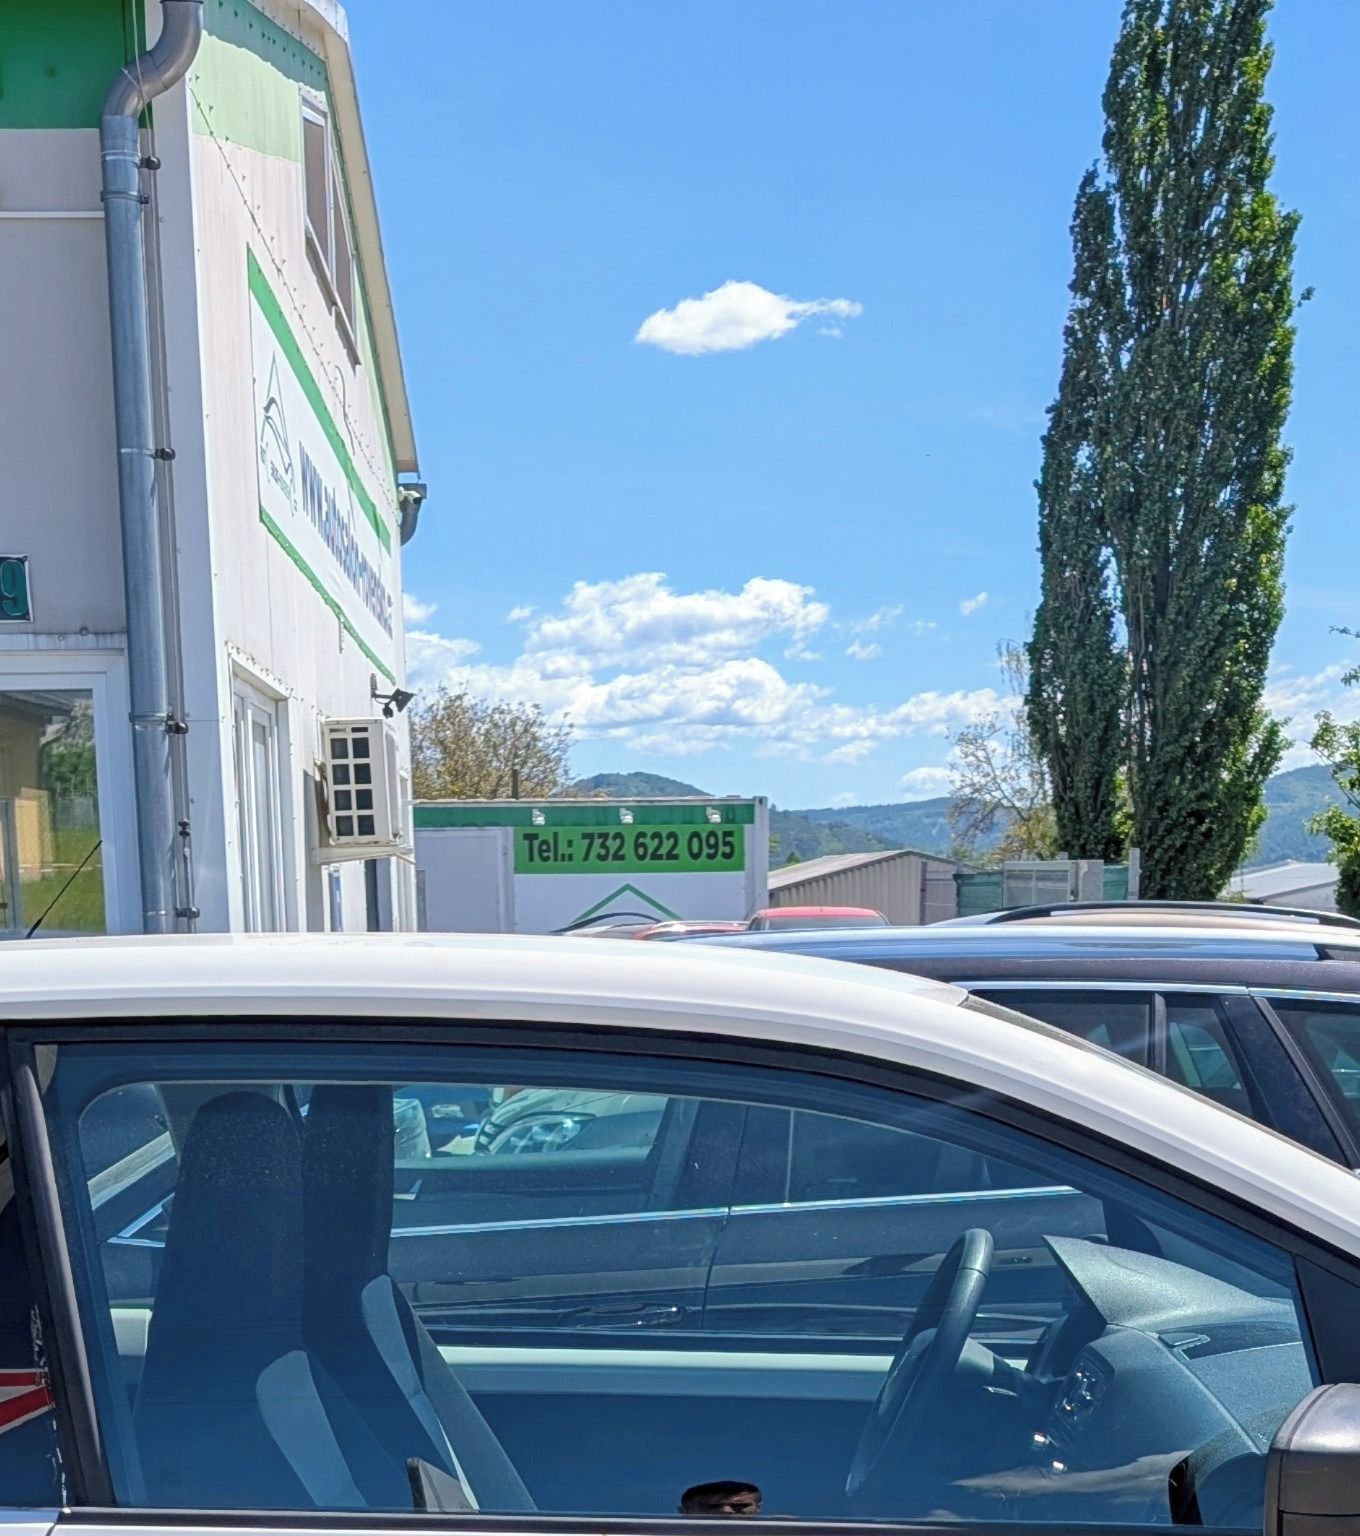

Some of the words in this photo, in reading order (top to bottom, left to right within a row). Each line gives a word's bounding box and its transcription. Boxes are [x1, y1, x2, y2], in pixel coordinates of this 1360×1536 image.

[523, 831, 574, 864] Tel.:
[581, 830, 626, 863] 732
[633, 830, 680, 862] 622
[687, 829, 736, 861] 095
